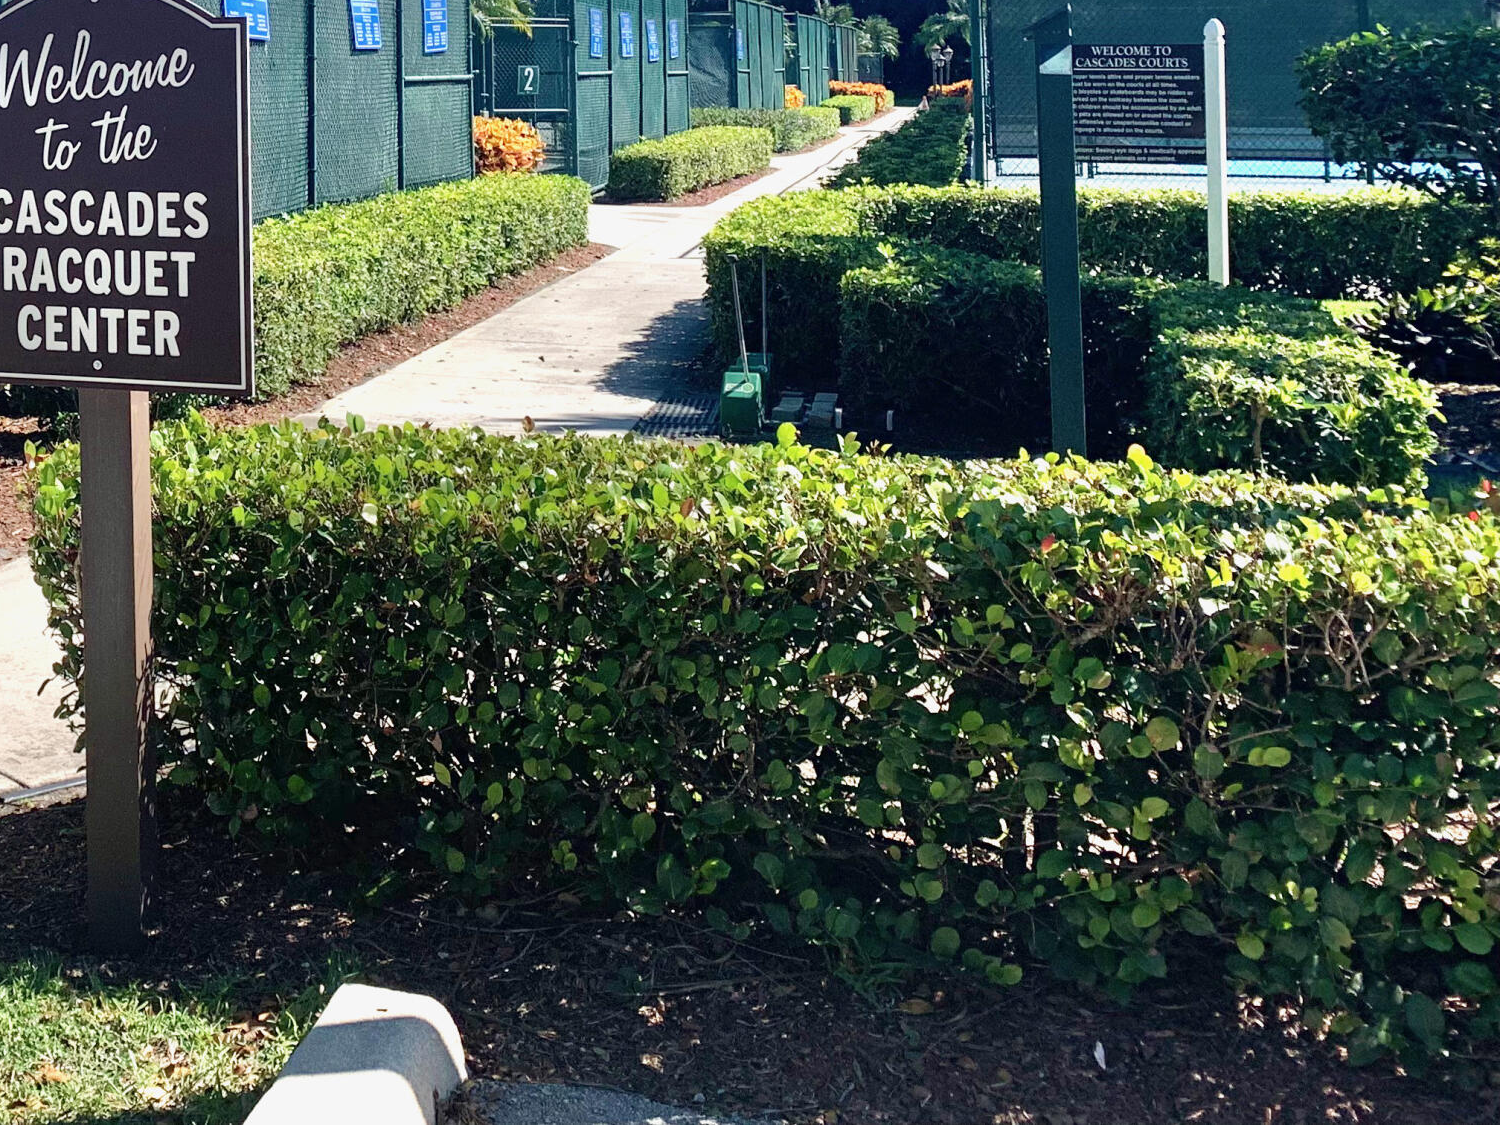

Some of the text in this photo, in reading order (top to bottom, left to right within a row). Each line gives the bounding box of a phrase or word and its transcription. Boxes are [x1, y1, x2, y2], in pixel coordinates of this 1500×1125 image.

[1075, 57, 1189, 67] CASCADES COURTS
[1091, 46, 1172, 55] WELCOME TO
[523, 67, 534, 91] 2
[34, 104, 157, 171] to the
[2, 246, 196, 298] RACQUET
[16, 304, 181, 357] CENTER
